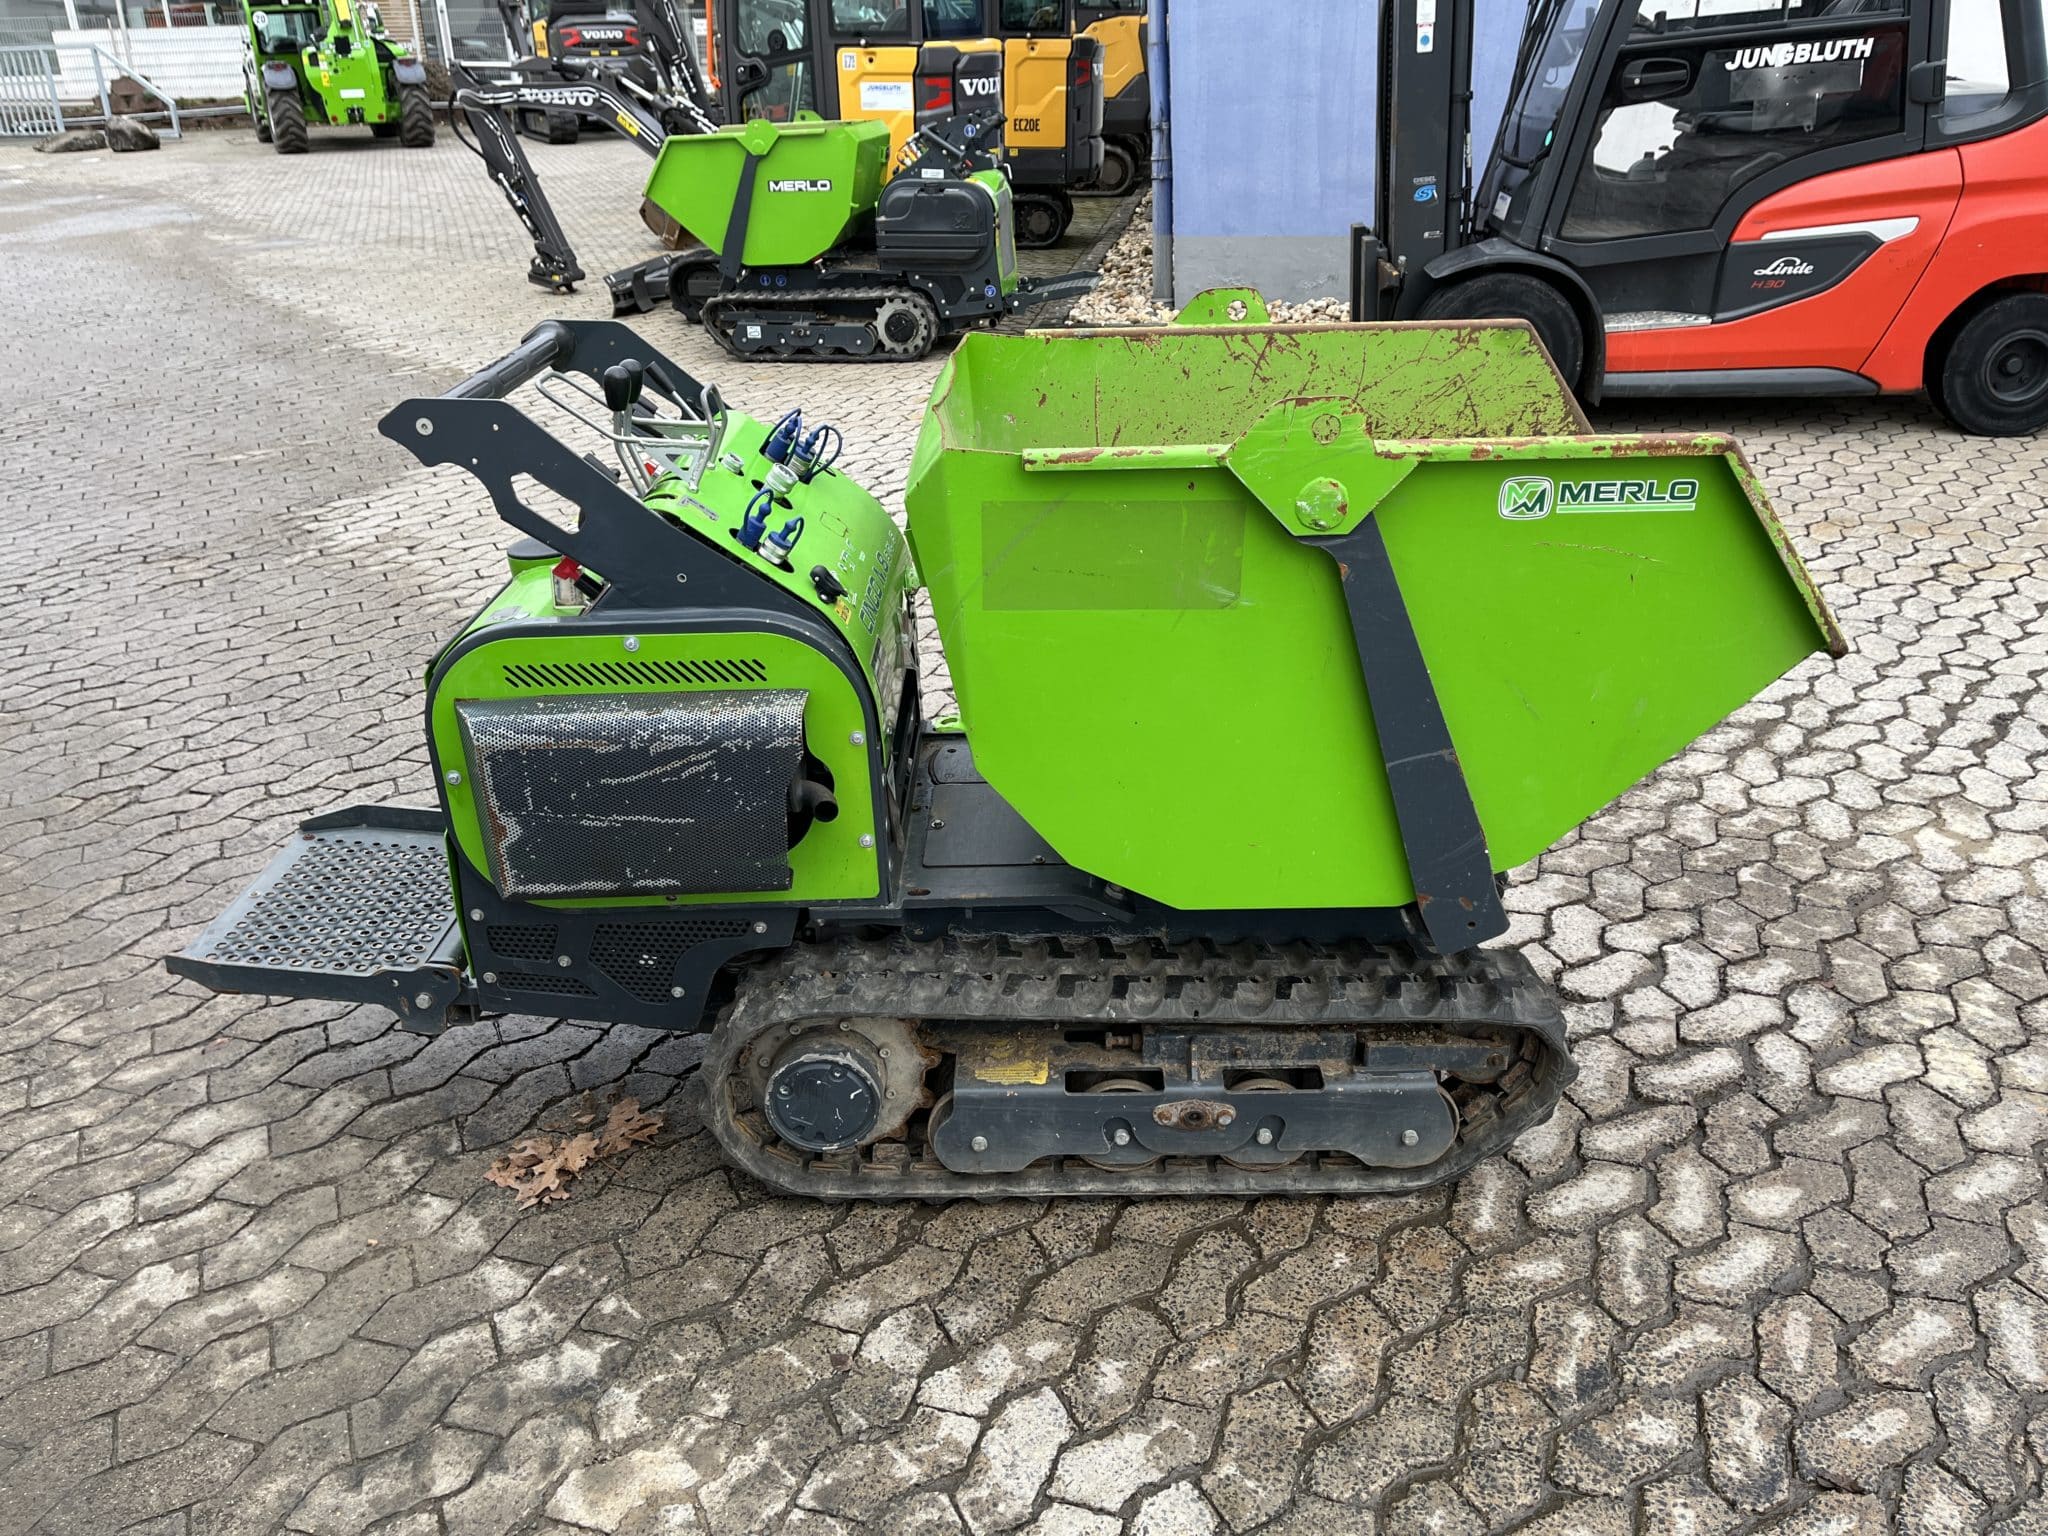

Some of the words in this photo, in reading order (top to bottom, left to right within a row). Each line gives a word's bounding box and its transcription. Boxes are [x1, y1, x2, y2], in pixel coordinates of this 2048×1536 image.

[581, 30, 623, 40] VOLVO
[1725, 37, 1875, 71] JUNGBLUTH
[521, 88, 595, 107] VOLVO
[1013, 118, 1041, 132] EC20E
[768, 180, 831, 192] MERLO
[1753, 256, 1814, 276] Linde
[1558, 479, 1699, 504] MERLO
